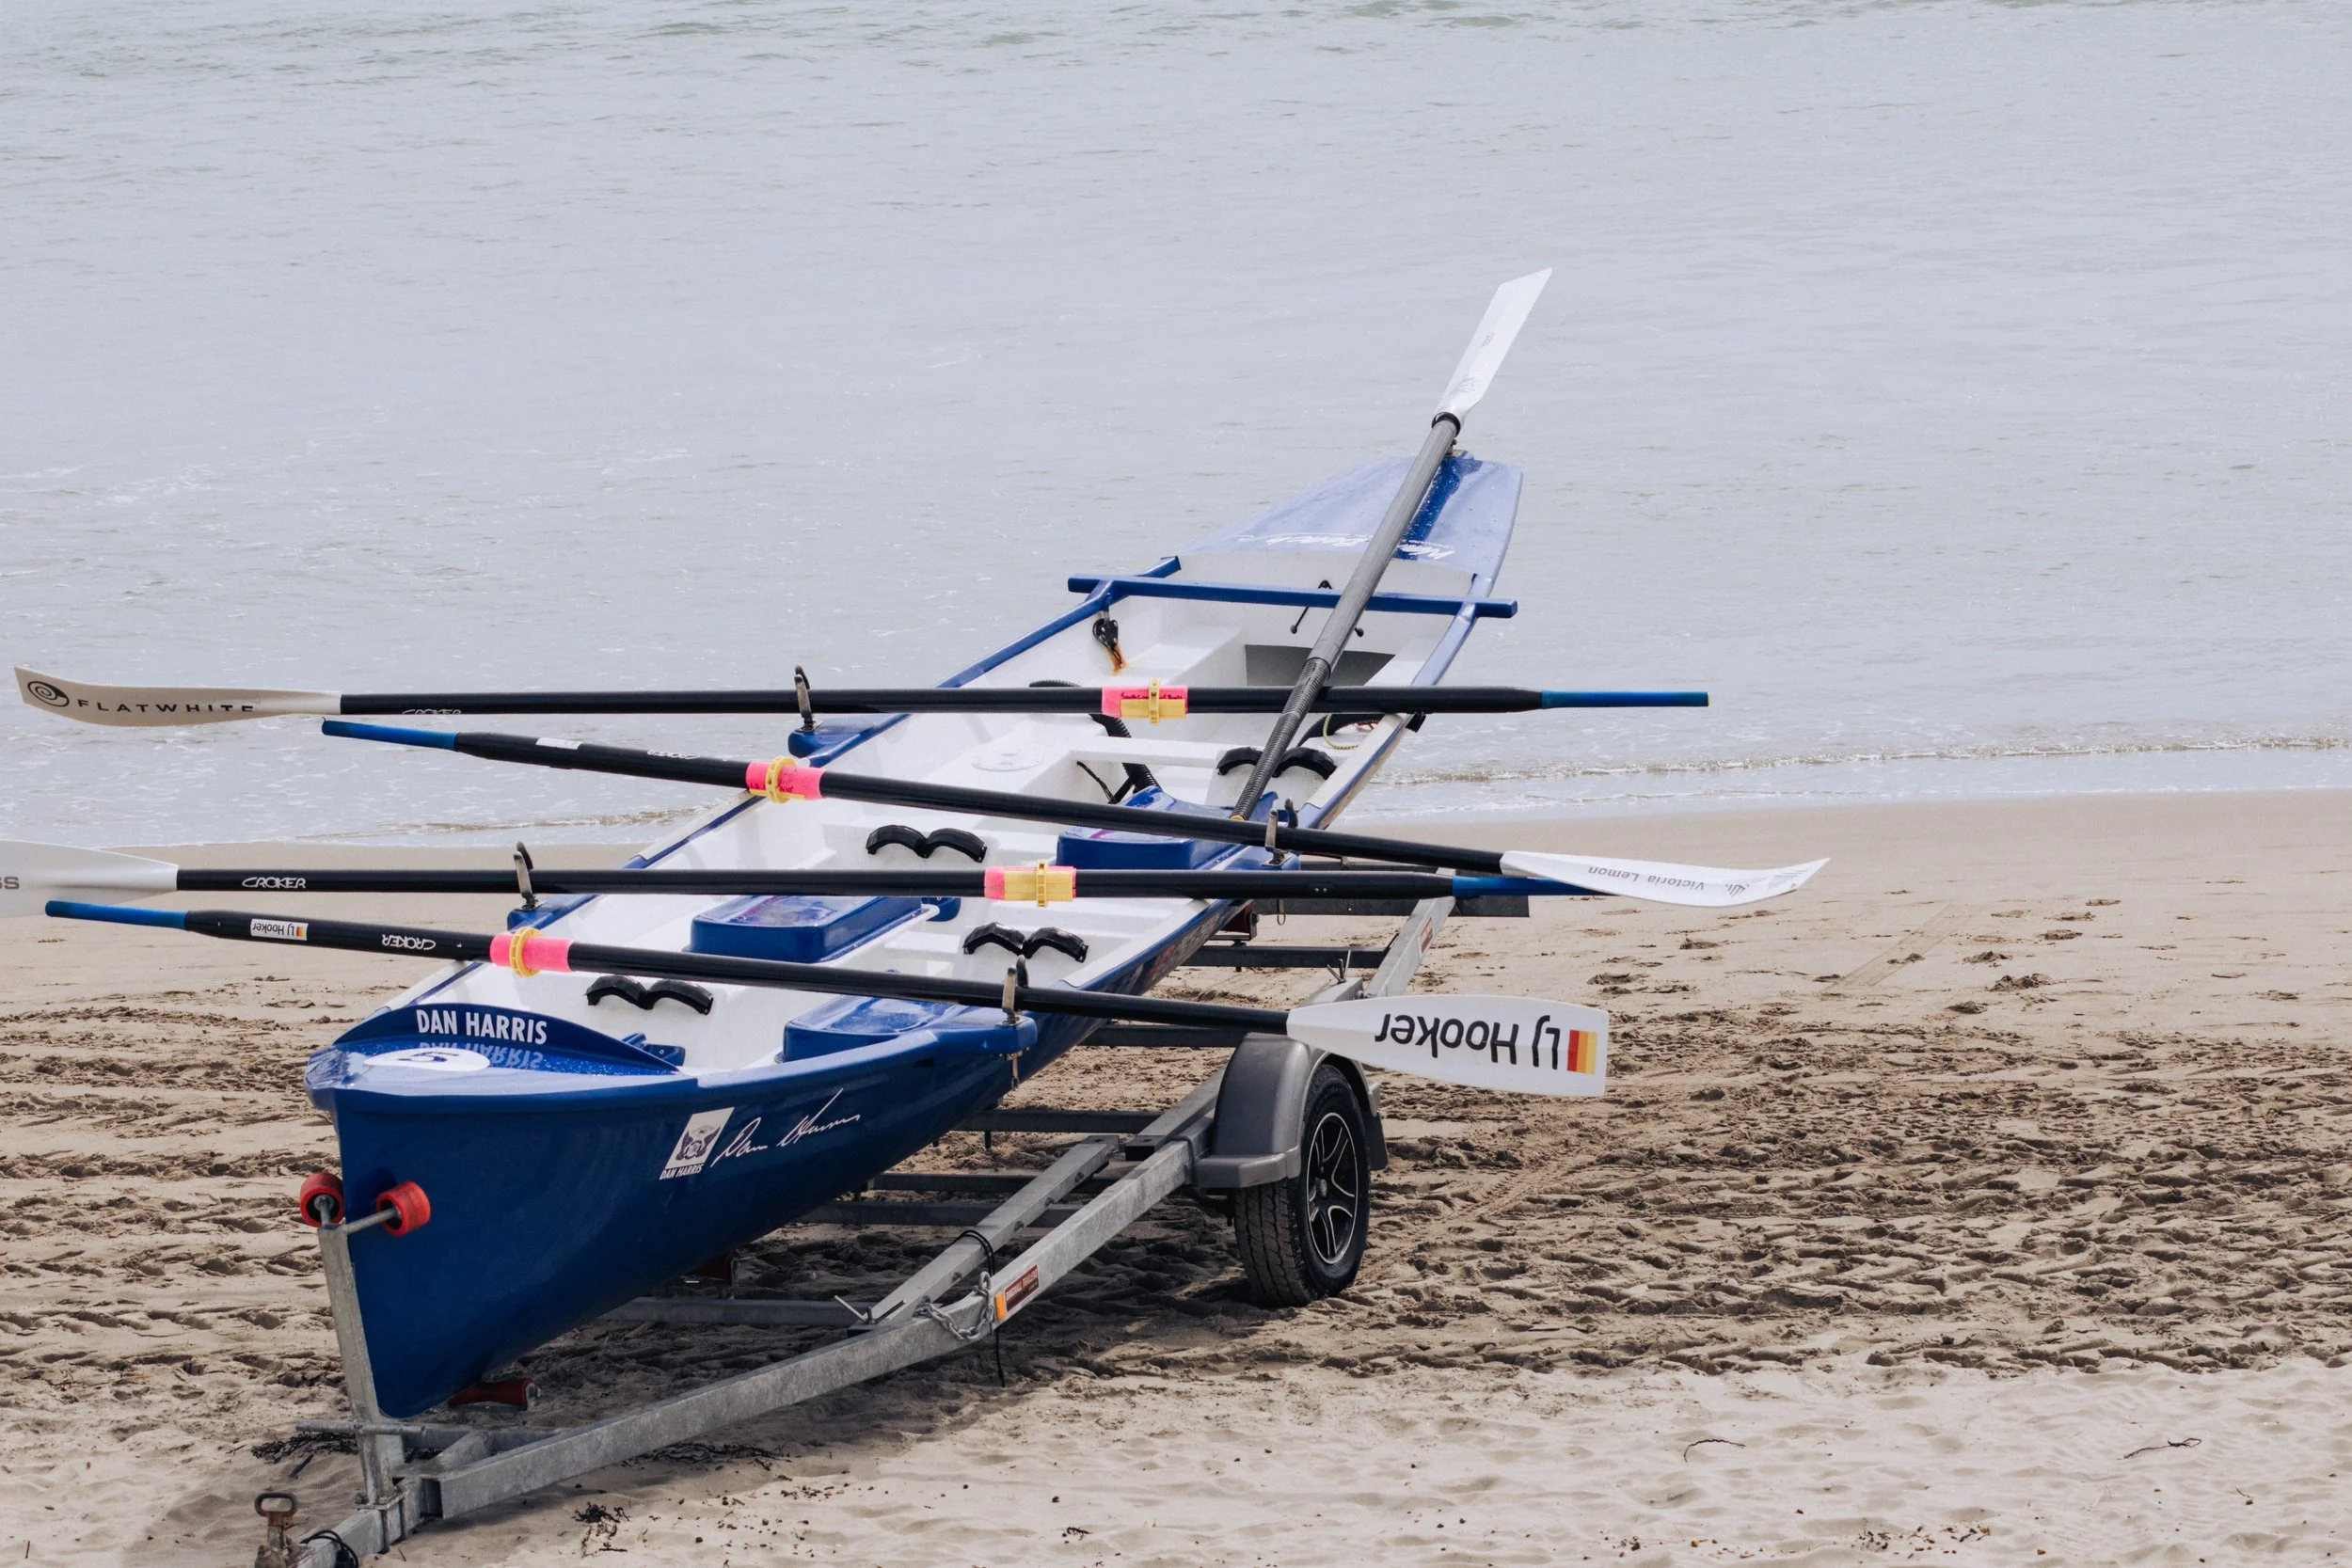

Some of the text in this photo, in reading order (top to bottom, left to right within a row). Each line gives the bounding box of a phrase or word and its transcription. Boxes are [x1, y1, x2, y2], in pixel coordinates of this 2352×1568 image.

[77, 699, 253, 713] FLATWHITE
[242, 876, 306, 889] CROKER
[1587, 865, 1705, 891] Victoria Lemon
[252, 923, 294, 937] LJ Hooker
[381, 934, 437, 951] CROKER
[416, 1009, 548, 1045] DAN HARRIS
[1375, 1013, 1561, 1070] LJ Hooker
[659, 1164, 705, 1180] DAN HARRIS
